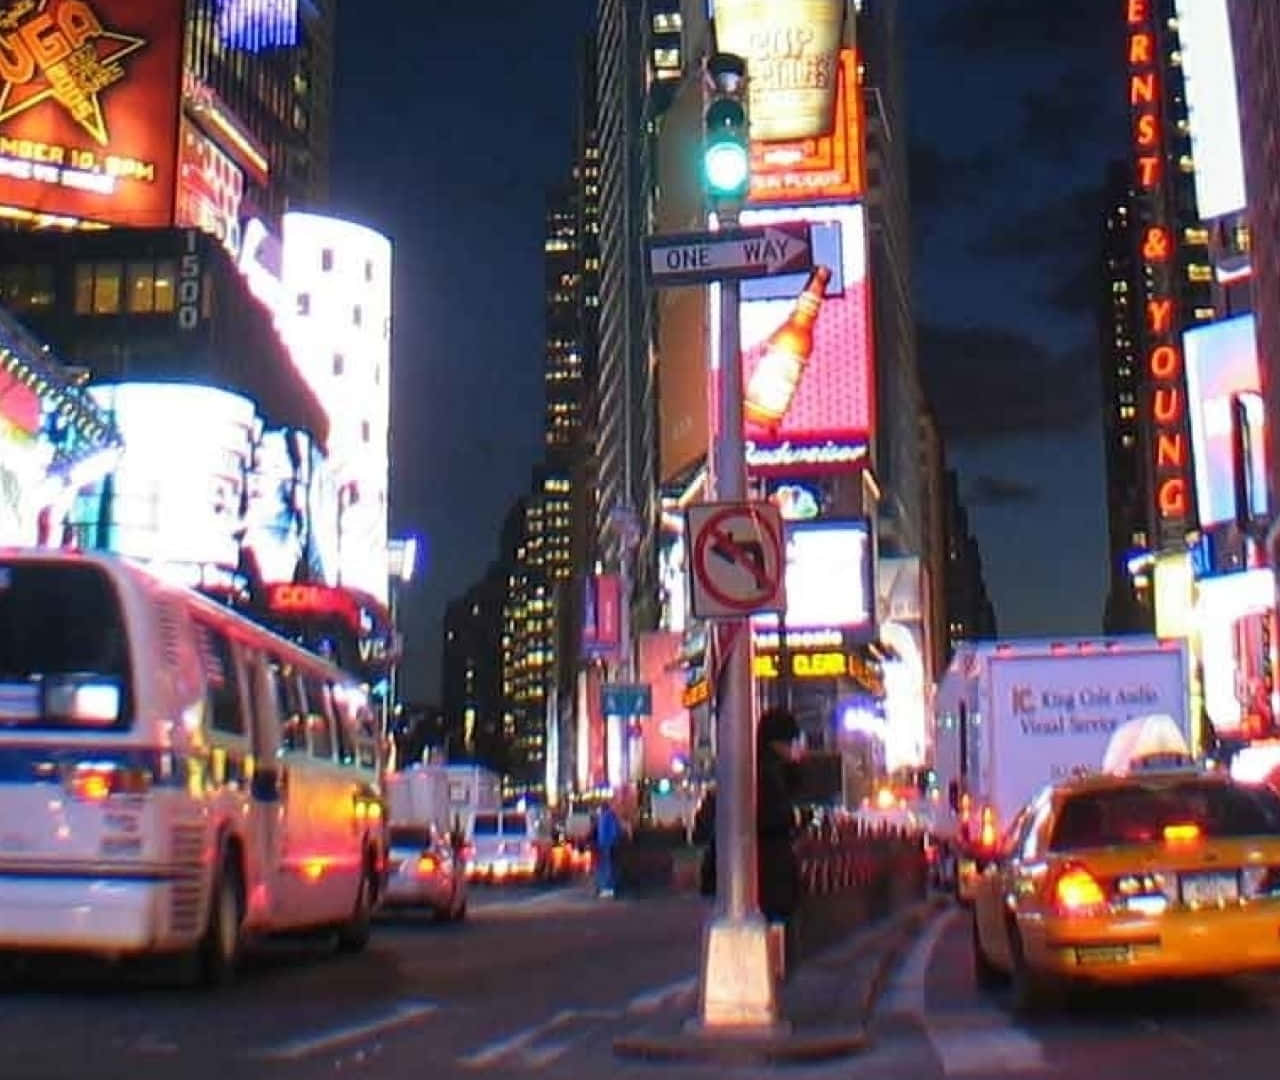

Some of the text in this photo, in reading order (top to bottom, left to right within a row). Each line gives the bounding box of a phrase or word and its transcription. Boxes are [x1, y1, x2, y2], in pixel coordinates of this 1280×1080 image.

[666, 238, 788, 269] ONE WAY
[1144, 227, 1167, 260] &
[178, 229, 199, 329] 1500
[1149, 301, 1186, 514] YOUNG
